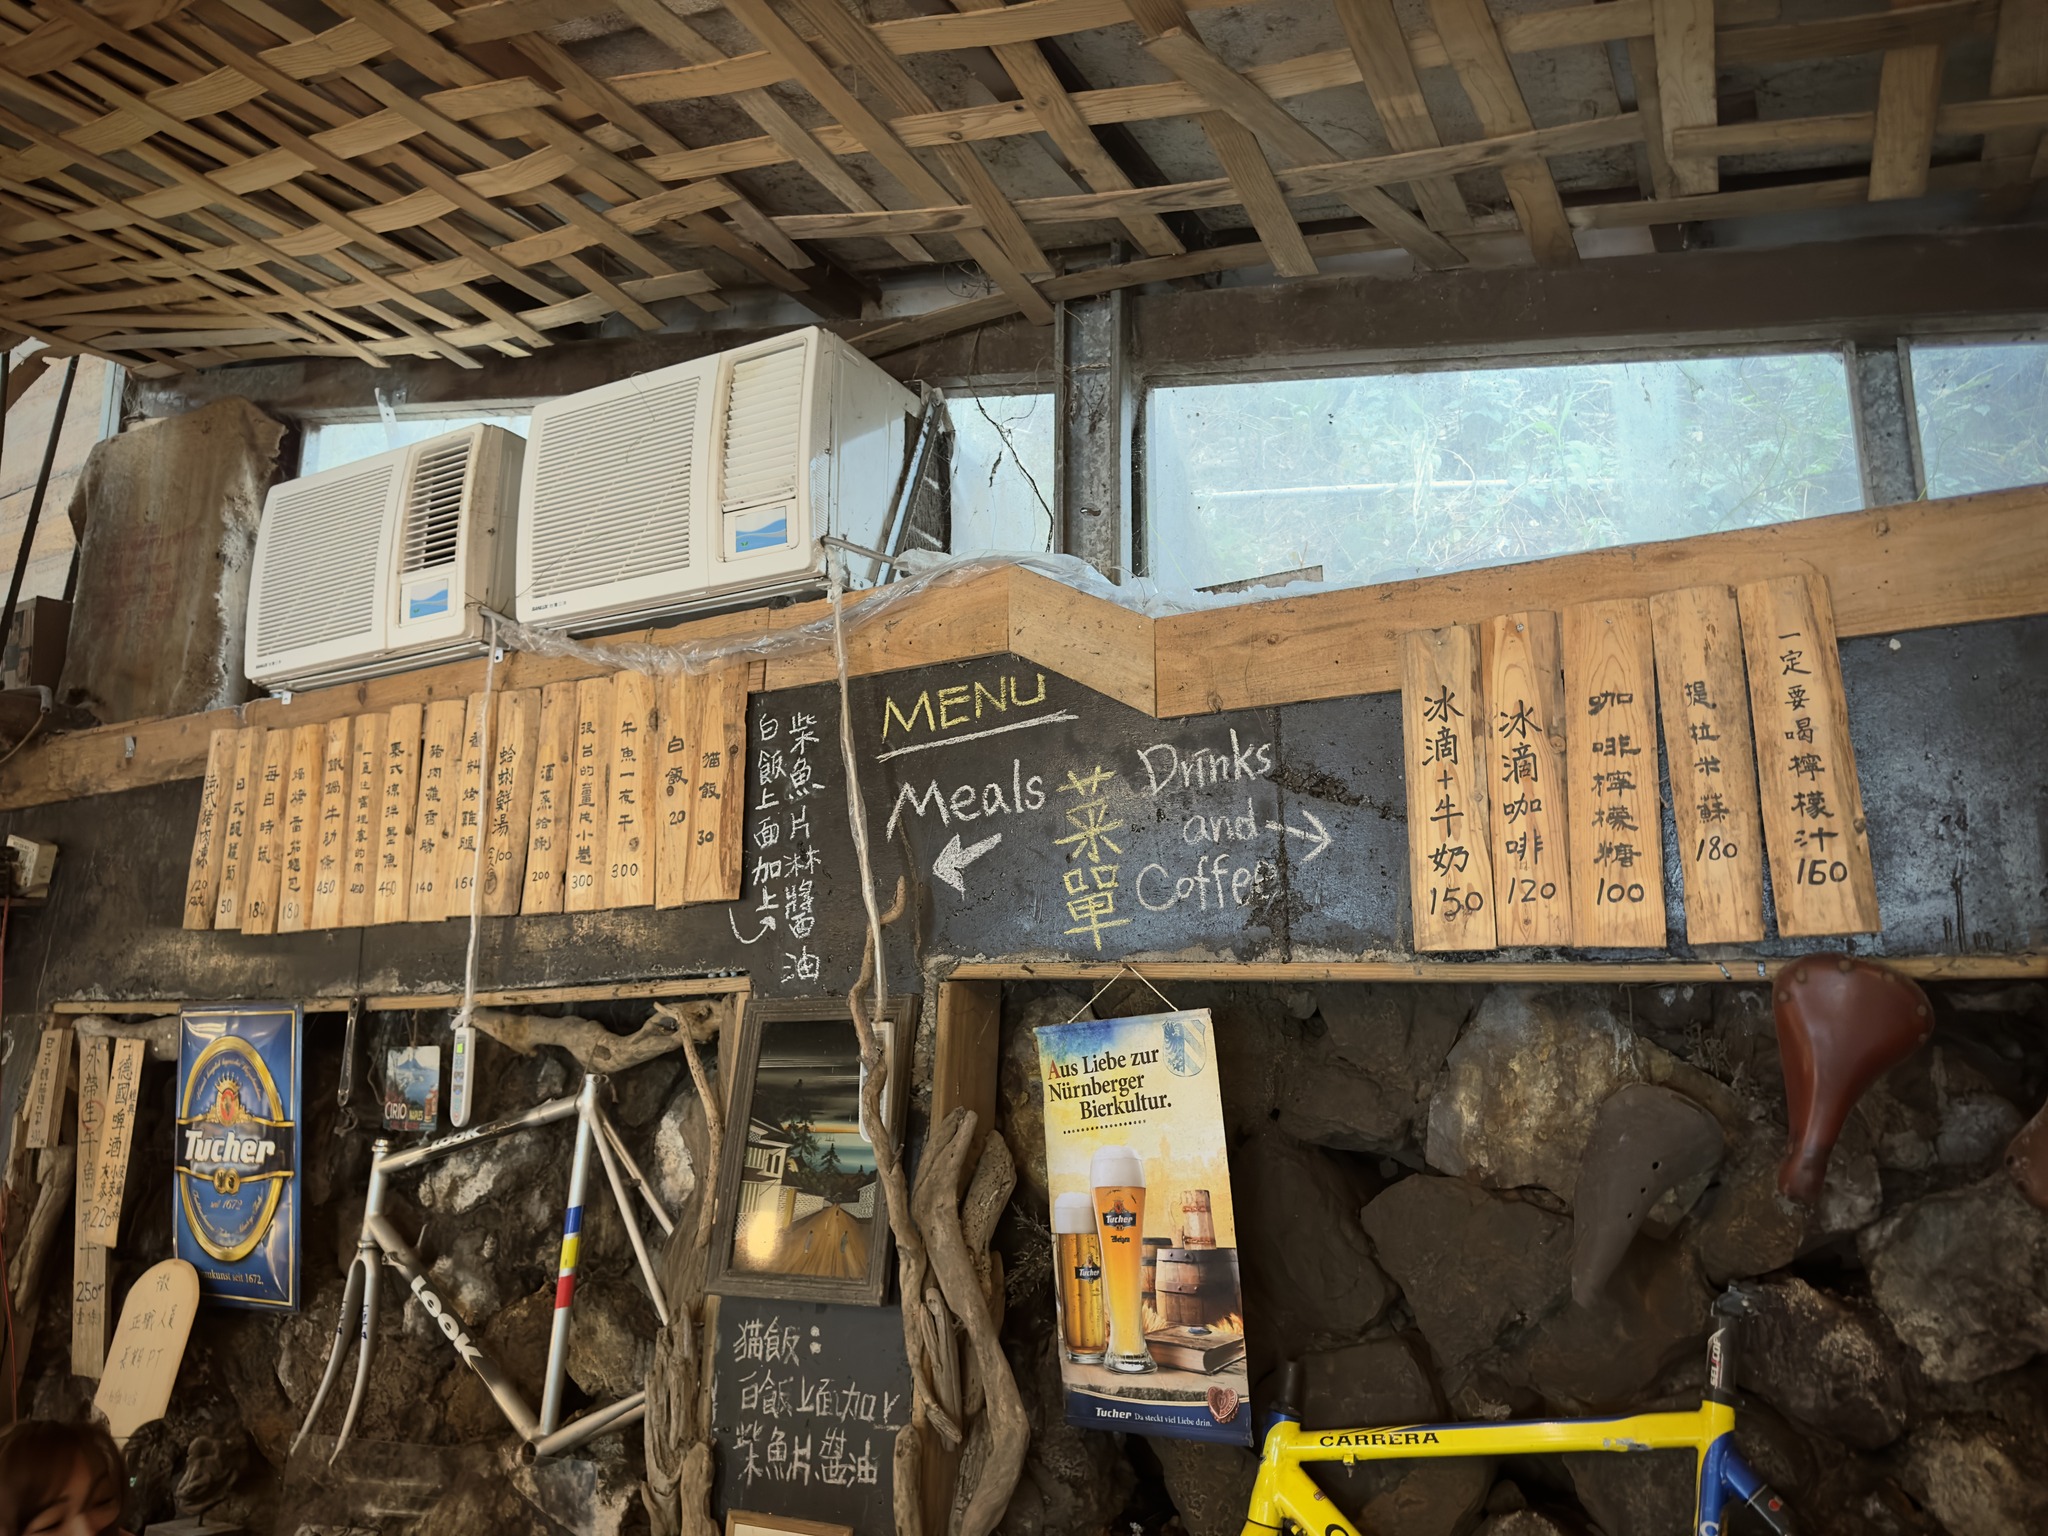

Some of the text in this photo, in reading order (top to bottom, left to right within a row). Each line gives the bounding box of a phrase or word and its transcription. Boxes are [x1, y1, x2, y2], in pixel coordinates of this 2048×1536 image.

[881, 673, 1046, 743] MENU
[1137, 728, 1272, 796] Drinks
[1685, 681, 1737, 862] 提拉米蘇 180
[1777, 632, 1848, 885] 一定要喝檸檬汁 160
[665, 735, 689, 826] 白飯 20
[491, 743, 517, 864] 蛤蜊鮮湯 100
[611, 720, 639, 879] 午魚一夜干 300
[752, 713, 787, 912] 白飯上面加上
[886, 758, 1046, 842] Meals
[1499, 699, 1556, 904] 冰滴咖啡 120
[1588, 690, 1645, 905] 咖啡檸檬糖 100
[532, 763, 556, 882] 酒蒸蛤蜊 200
[1183, 798, 1259, 846] and
[697, 829, 715, 846] 30
[1052, 765, 1132, 951] 菜單
[316, 879, 336, 896] 450
[378, 881, 397, 898] 450
[415, 881, 433, 894] 140
[571, 874, 594, 889] 300
[220, 898, 232, 914] 50
[249, 901, 266, 918] 180
[282, 902, 300, 920] 180
[1429, 887, 1482, 917] 150
[1048, 1049, 1159, 1080] Aus Liebe zur
[1048, 1074, 1145, 1102] Nürnberger
[384, 1101, 408, 1120] CIRIO
[1079, 1092, 1172, 1120] Bierkultur.
[185, 1129, 276, 1164] Tucher
[90, 1205, 112, 1228] 220
[1106, 1215, 1133, 1224] Tucher
[76, 1281, 98, 1302] 250
[410, 1275, 483, 1369] LOOK
[1096, 1407, 1213, 1427] Tucher Da steckt viel Liebe drin.
[1319, 1432, 1440, 1448] CARRERA
